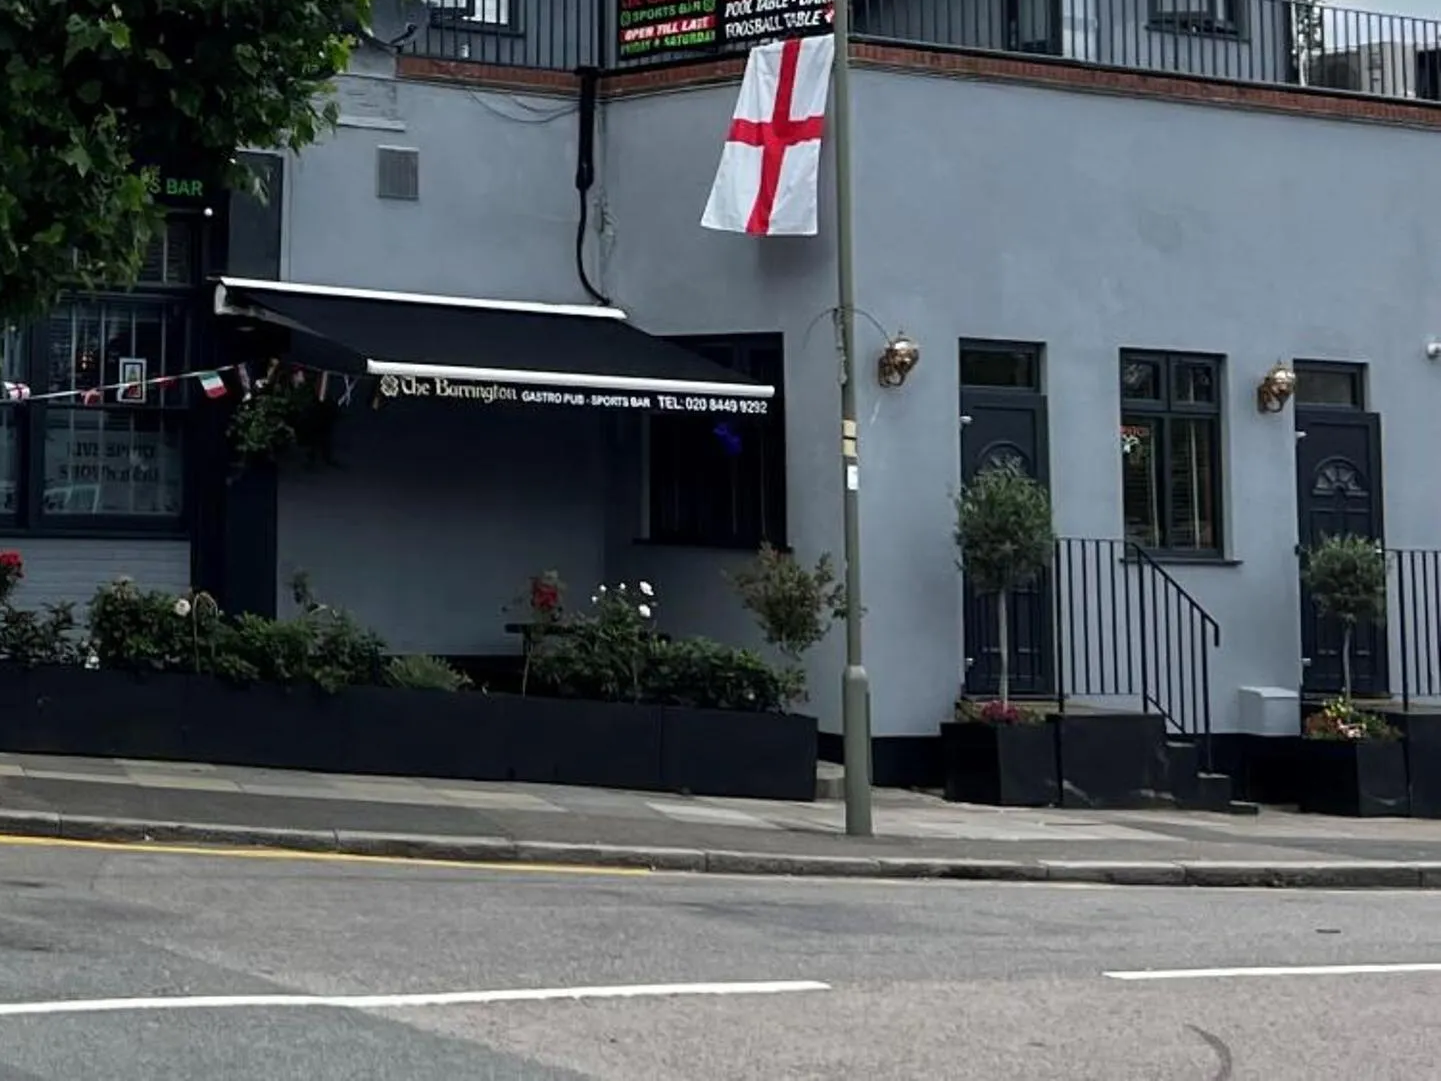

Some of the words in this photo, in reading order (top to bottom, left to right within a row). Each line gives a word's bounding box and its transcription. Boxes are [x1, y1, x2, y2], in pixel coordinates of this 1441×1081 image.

[632, 6, 677, 21] SPORTS
[725, 2, 753, 18] POOL
[625, 25, 656, 41] OPEN
[656, 21, 680, 36] TILL
[725, 19, 783, 39] FOOSBALL
[783, 9, 825, 29] TABLE
[165, 177, 203, 196] BAR
[400, 376, 431, 396] The
[435, 377, 517, 404] Barrington
[521, 390, 562, 405] GASTRO
[562, 393, 585, 406] PUB
[591, 394, 629, 408] SPORTS
[629, 395, 651, 408] BAR
[686, 397, 708, 412] 020
